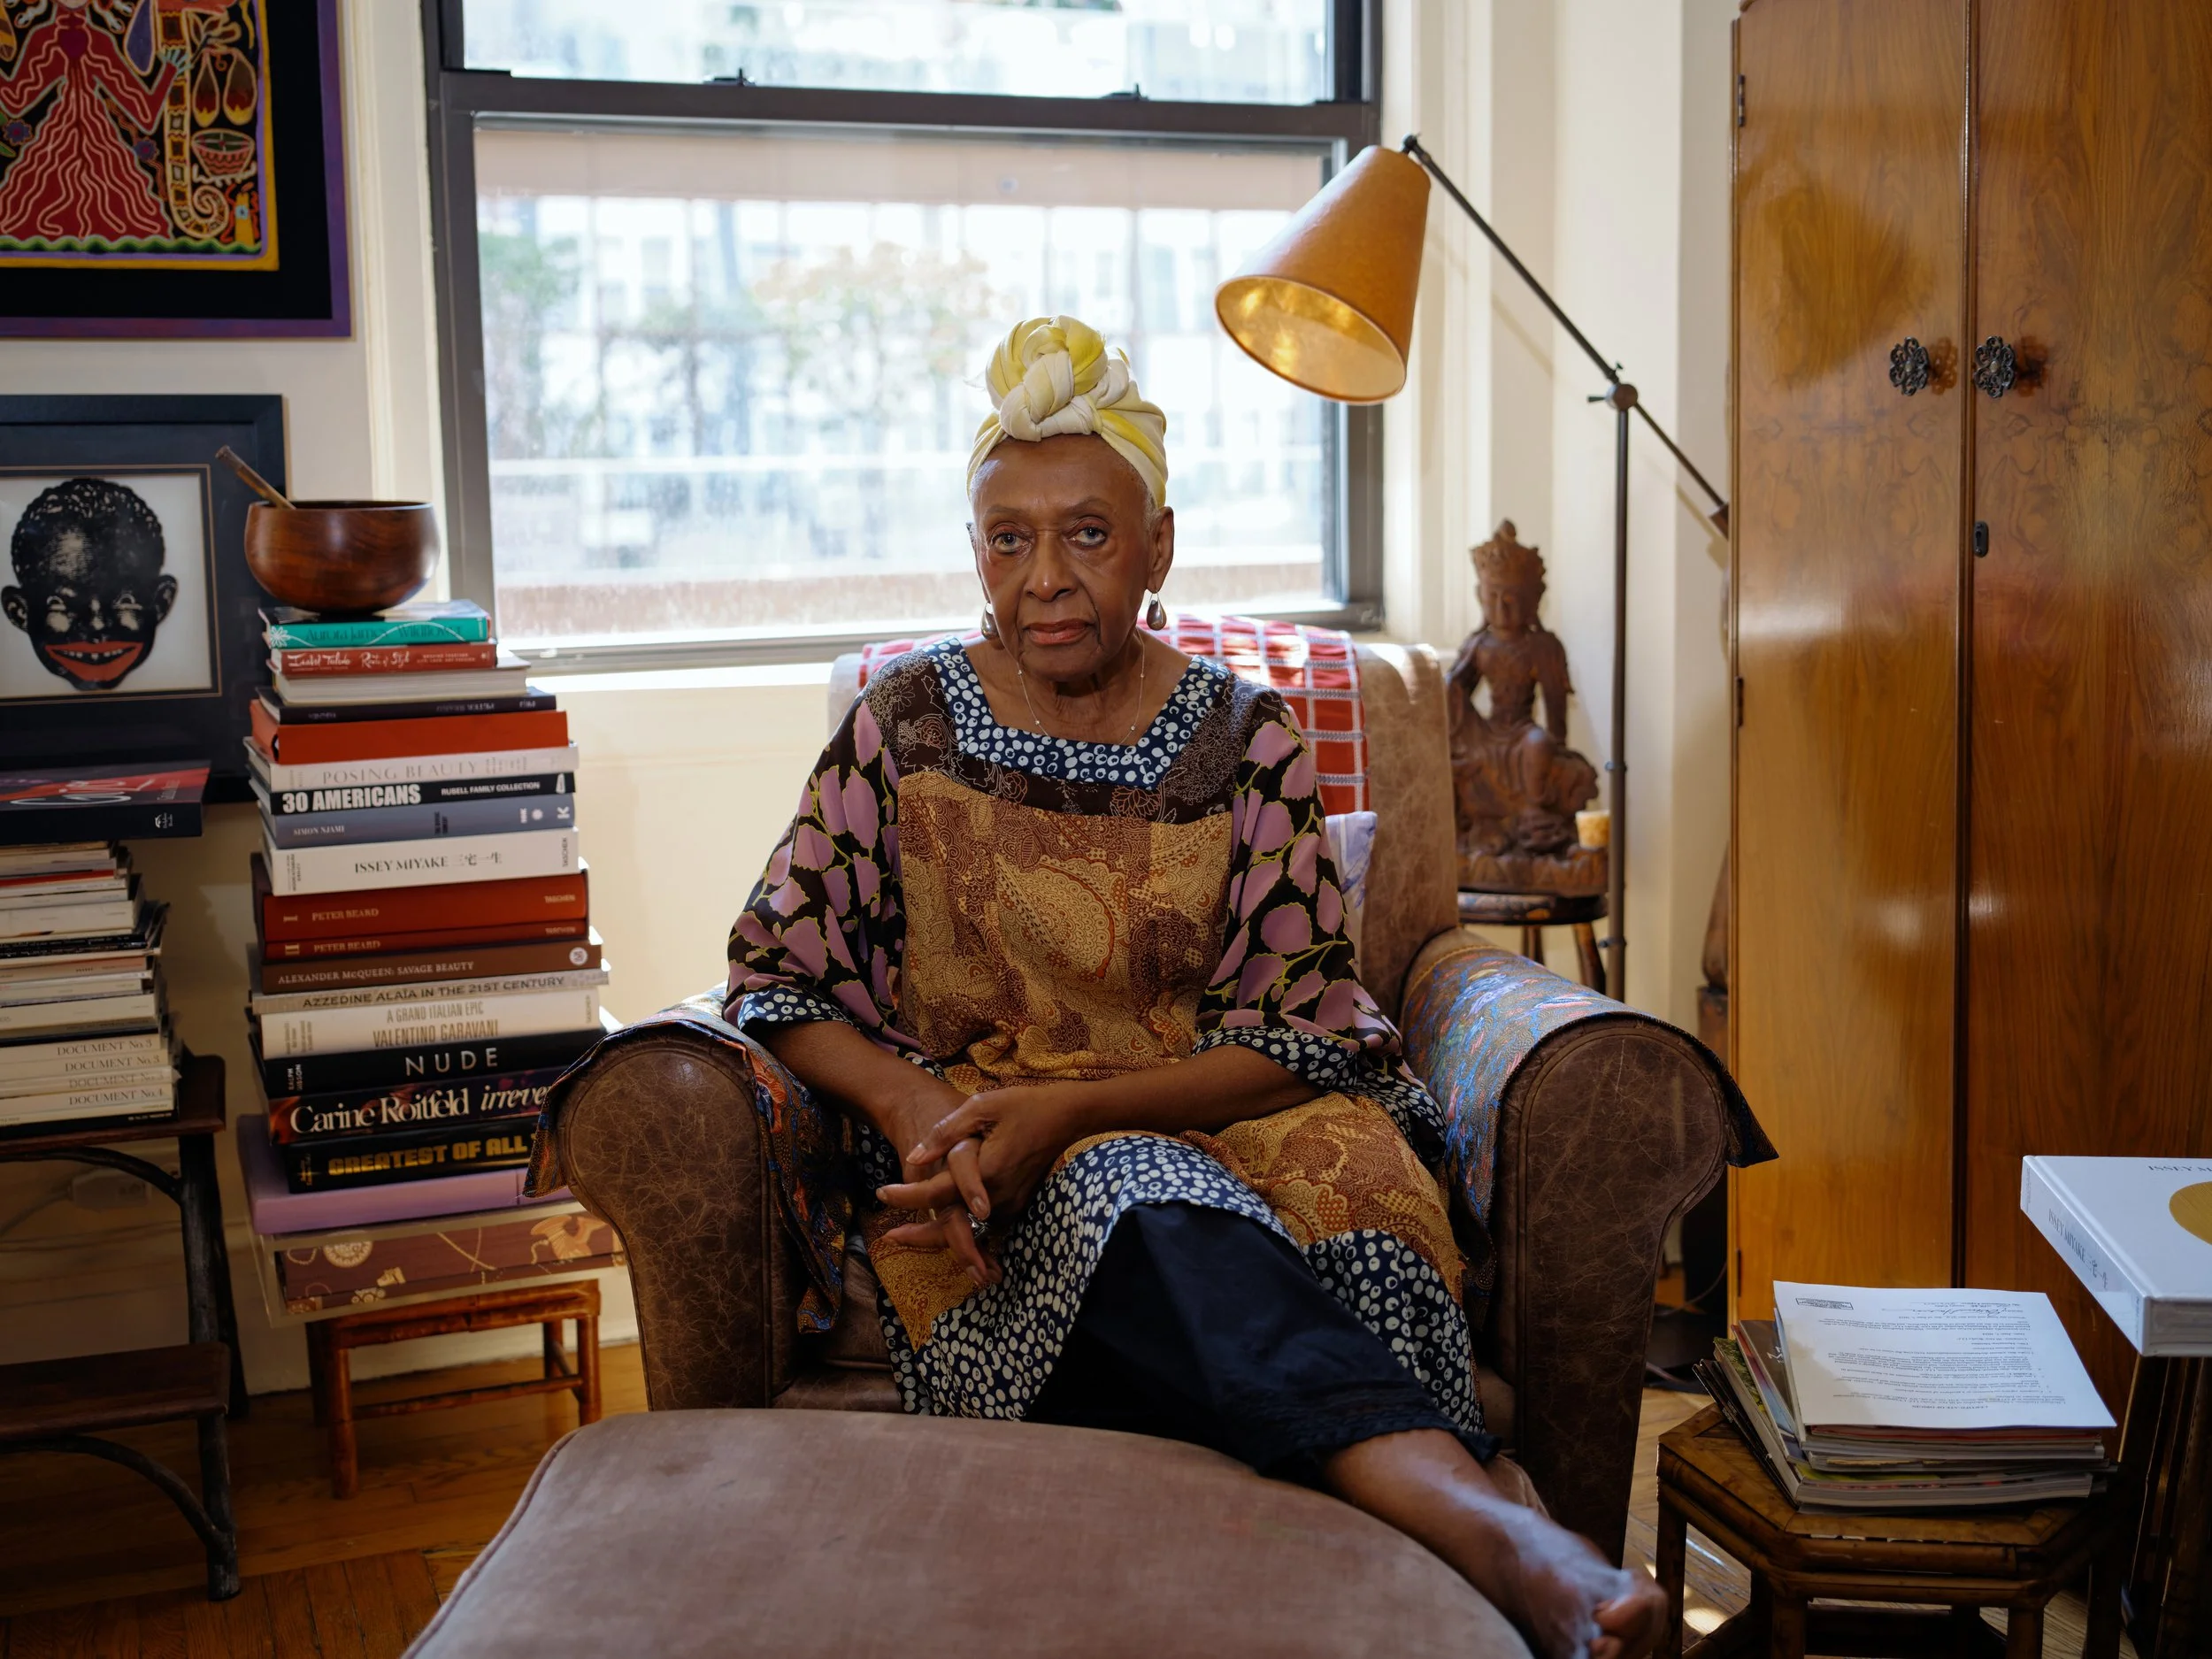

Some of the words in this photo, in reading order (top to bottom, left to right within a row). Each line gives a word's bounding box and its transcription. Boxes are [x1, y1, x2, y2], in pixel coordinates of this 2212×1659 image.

[323, 767, 397, 785] POSING
[405, 760, 476, 782] BEAUTY
[281, 791, 309, 814] 30
[311, 783, 422, 811] AMERICANS
[441, 787, 469, 796] RUBELL
[470, 784, 495, 794] FAMILY
[495, 781, 541, 792] COLLECTION
[293, 826, 319, 836] SIMON
[320, 824, 346, 834] NJAMI
[354, 860, 394, 874] ISSEY
[396, 855, 449, 872] MIYAKE
[311, 910, 345, 922] PETER
[345, 907, 380, 918] BEARD
[313, 941, 346, 953] PETER
[347, 940, 381, 951] BEARD
[278, 971, 340, 985] ALEXANDER
[396, 964, 434, 976] SAVAGE
[435, 961, 475, 973] BEAUTY
[303, 993, 373, 1009] AZZEDINE
[421, 987, 434, 997] IN
[438, 984, 465, 996] THE
[469, 981, 500, 994] 21ST
[503, 976, 565, 991] CENTURY
[387, 1009, 394, 1024] A
[396, 1005, 426, 1023] GRAND
[428, 1002, 463, 1020] ITALIAN
[465, 1001, 485, 1016] EPIC
[373, 1025, 436, 1048] VALENTINO
[440, 1018, 499, 1041] GARAVANI
[57, 1040, 126, 1056] DOCUMENT
[65, 1056, 133, 1072] DOCUMENT
[404, 1047, 498, 1077] NUDE
[68, 1072, 135, 1088] DOCUMENT
[69, 1090, 137, 1105] DOCUMENT
[289, 1102, 376, 1134] Carine
[380, 1087, 470, 1125] Roitfeld
[327, 1144, 448, 1176] GREATEST
[452, 1139, 481, 1161] OF
[486, 1134, 528, 1157] ALL
[2048, 1208, 2063, 1236] ISSEY
[2064, 1230, 2086, 1263] MIYAKE
